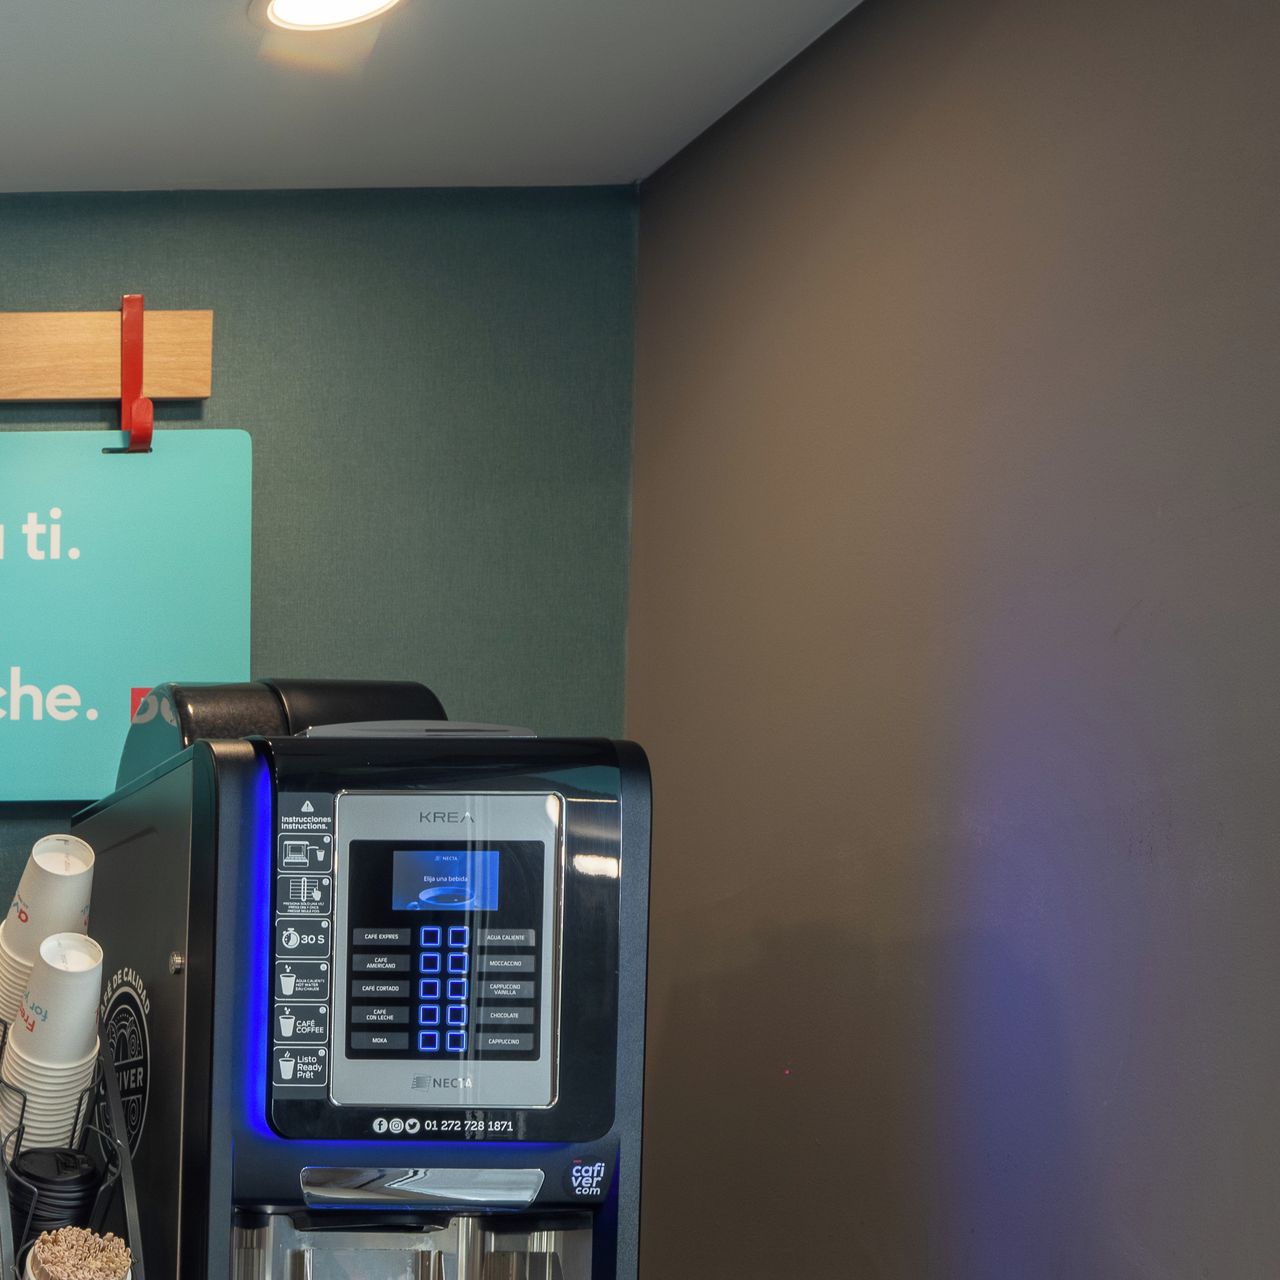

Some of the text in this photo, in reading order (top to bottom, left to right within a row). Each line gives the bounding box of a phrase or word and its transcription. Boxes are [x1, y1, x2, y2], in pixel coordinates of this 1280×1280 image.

[21, 506, 81, 561] ti.
[281, 815, 332, 823] Instrucciones
[420, 811, 474, 824] KREA
[448, 875, 469, 883] bebida
[301, 935, 325, 944] 30 S
[123, 966, 151, 1016] CALIDAD
[296, 1019, 315, 1027] CAFÉ
[296, 1026, 324, 1034] COFFEE
[297, 1055, 317, 1063] Listo
[297, 1063, 323, 1072] Ready
[297, 1071, 314, 1079] Prêt
[433, 1077, 473, 1089] NECTA
[424, 1120, 514, 1132] 01 272 728 1871
[572, 1162, 606, 1177] cafi
[571, 1176, 602, 1188] ver
[575, 1186, 601, 1196] com
